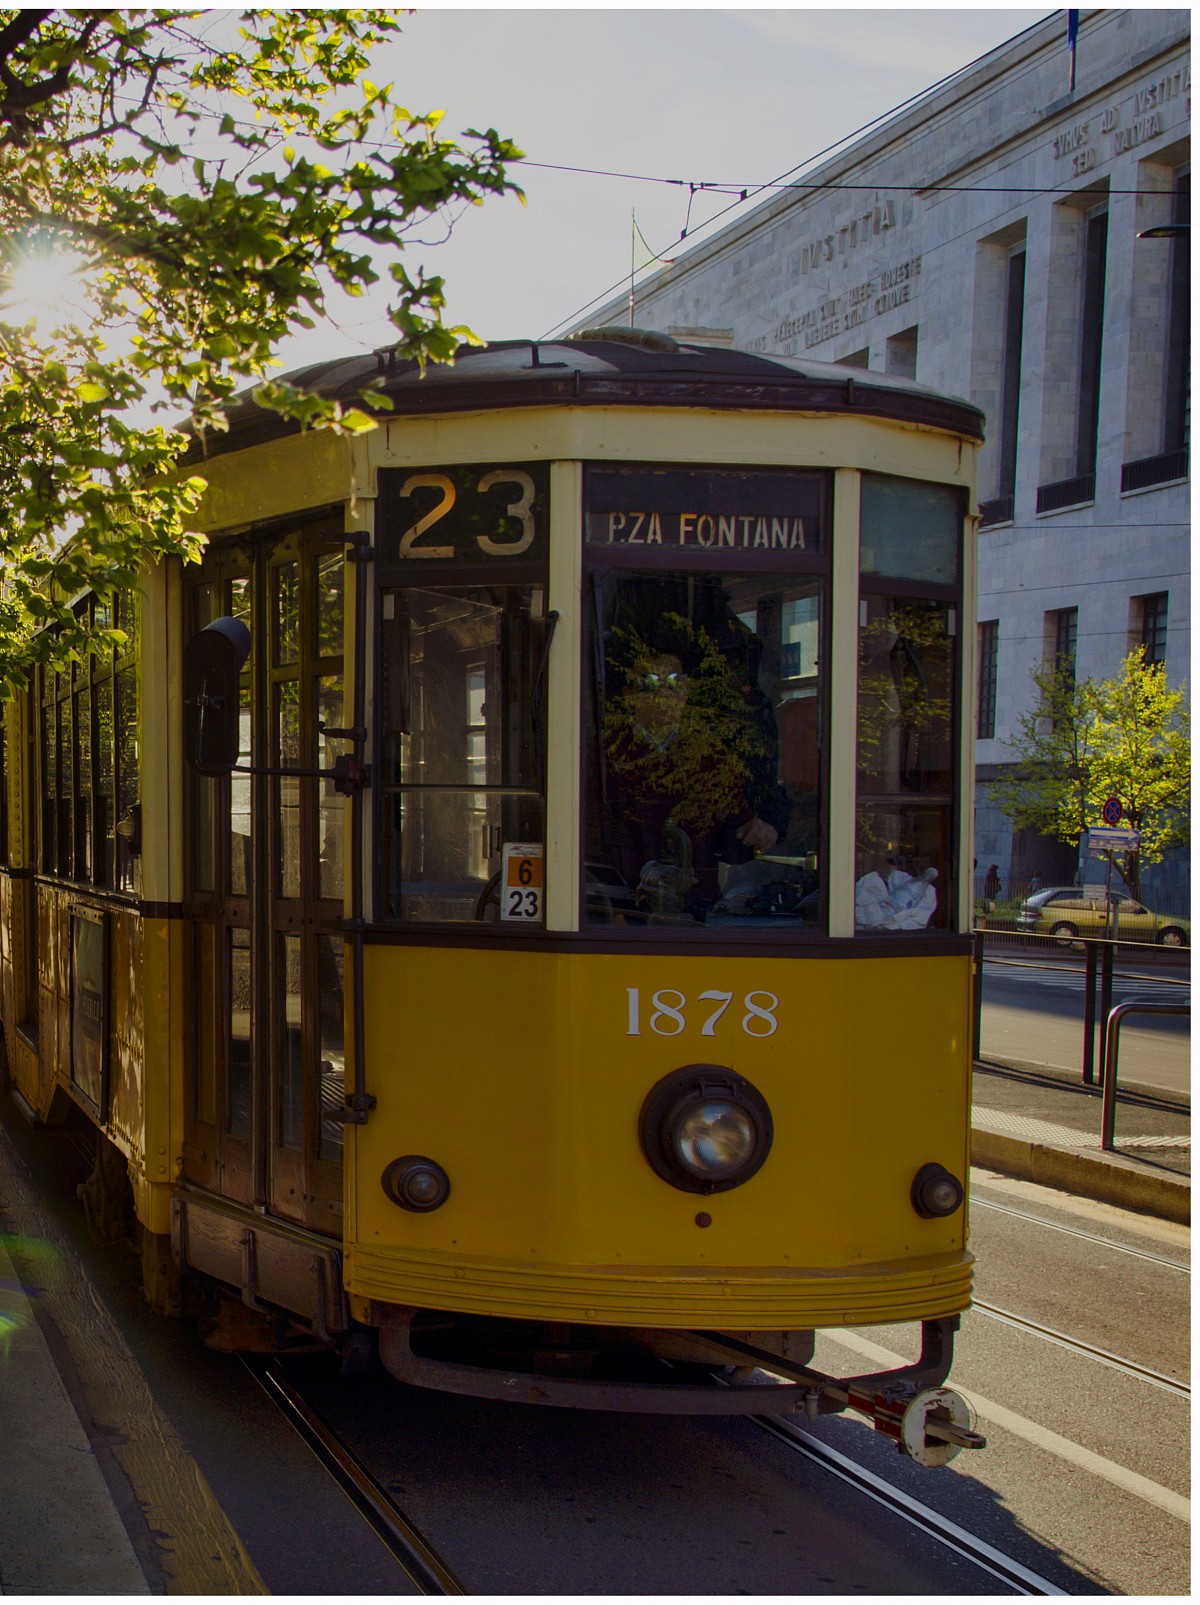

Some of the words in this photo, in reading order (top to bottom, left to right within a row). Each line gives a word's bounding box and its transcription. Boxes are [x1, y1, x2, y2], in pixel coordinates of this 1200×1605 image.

[1101, 107, 1120, 134] AD
[1073, 148, 1096, 178] SED
[801, 199, 895, 275] IVSTITIA
[398, 469, 536, 559] 23
[679, 512, 806, 549] FONTANA
[518, 859, 532, 885] 6
[508, 891, 538, 917] 23
[625, 988, 779, 1037] 1878
